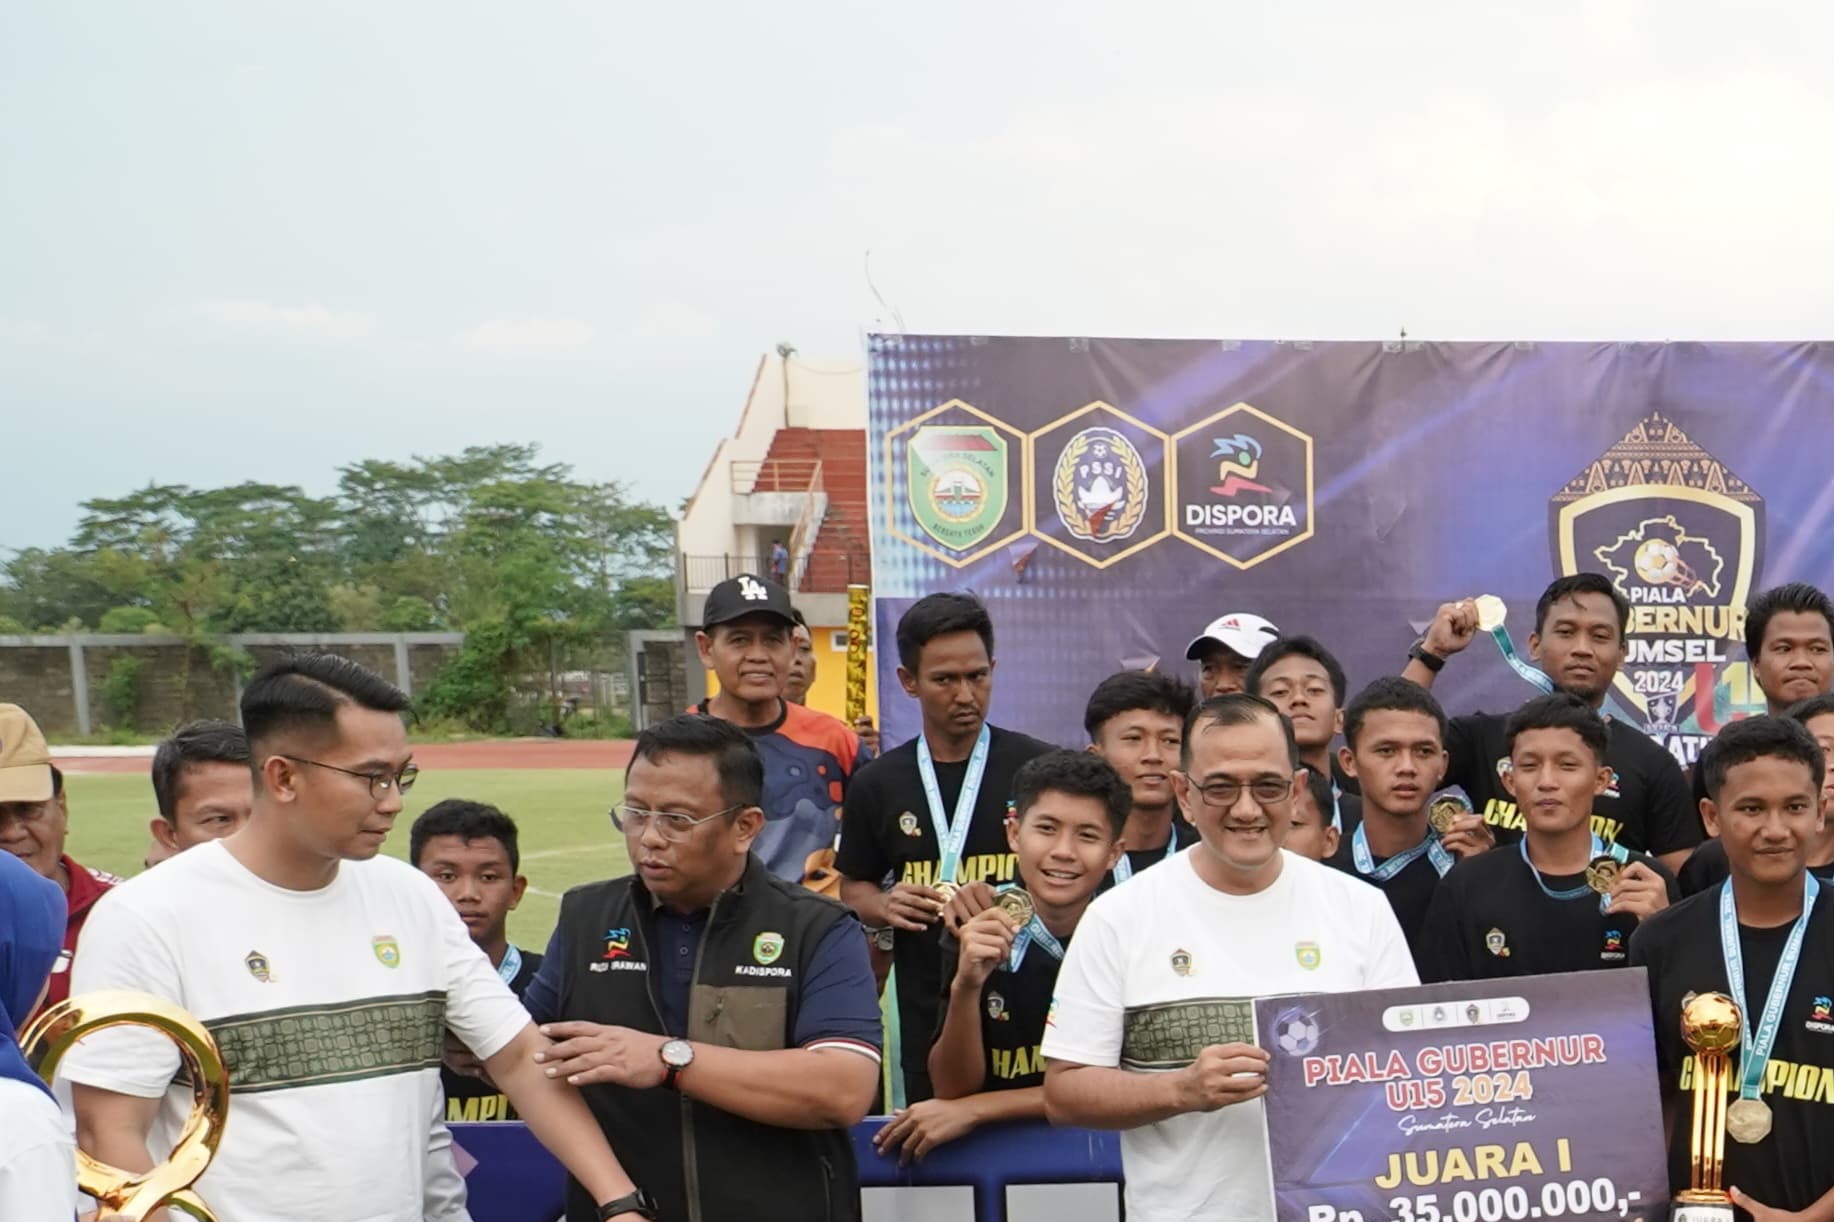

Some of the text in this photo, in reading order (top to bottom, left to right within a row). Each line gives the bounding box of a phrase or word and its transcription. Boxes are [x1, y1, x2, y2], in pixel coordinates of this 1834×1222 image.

[1079, 461, 1122, 479] PSSI
[1185, 504, 1297, 526] DISPORA
[1630, 586, 1687, 603] PIALA
[1624, 605, 1747, 642] BERNUR
[1624, 639, 1727, 663] UMSEL
[1634, 670, 1684, 693] 2024
[1694, 661, 1767, 736] U1
[735, 965, 792, 977] KADISPORA
[1755, 1023, 1773, 1056] PIALA
[1766, 961, 1791, 1021] GUBERNUR
[1304, 1035, 1607, 1086] PIALA GUBERNUR
[1386, 1071, 1533, 1111] U15 2024
[1475, 1107, 1536, 1127] Selatan
[1375, 1143, 1544, 1191] JUARA
